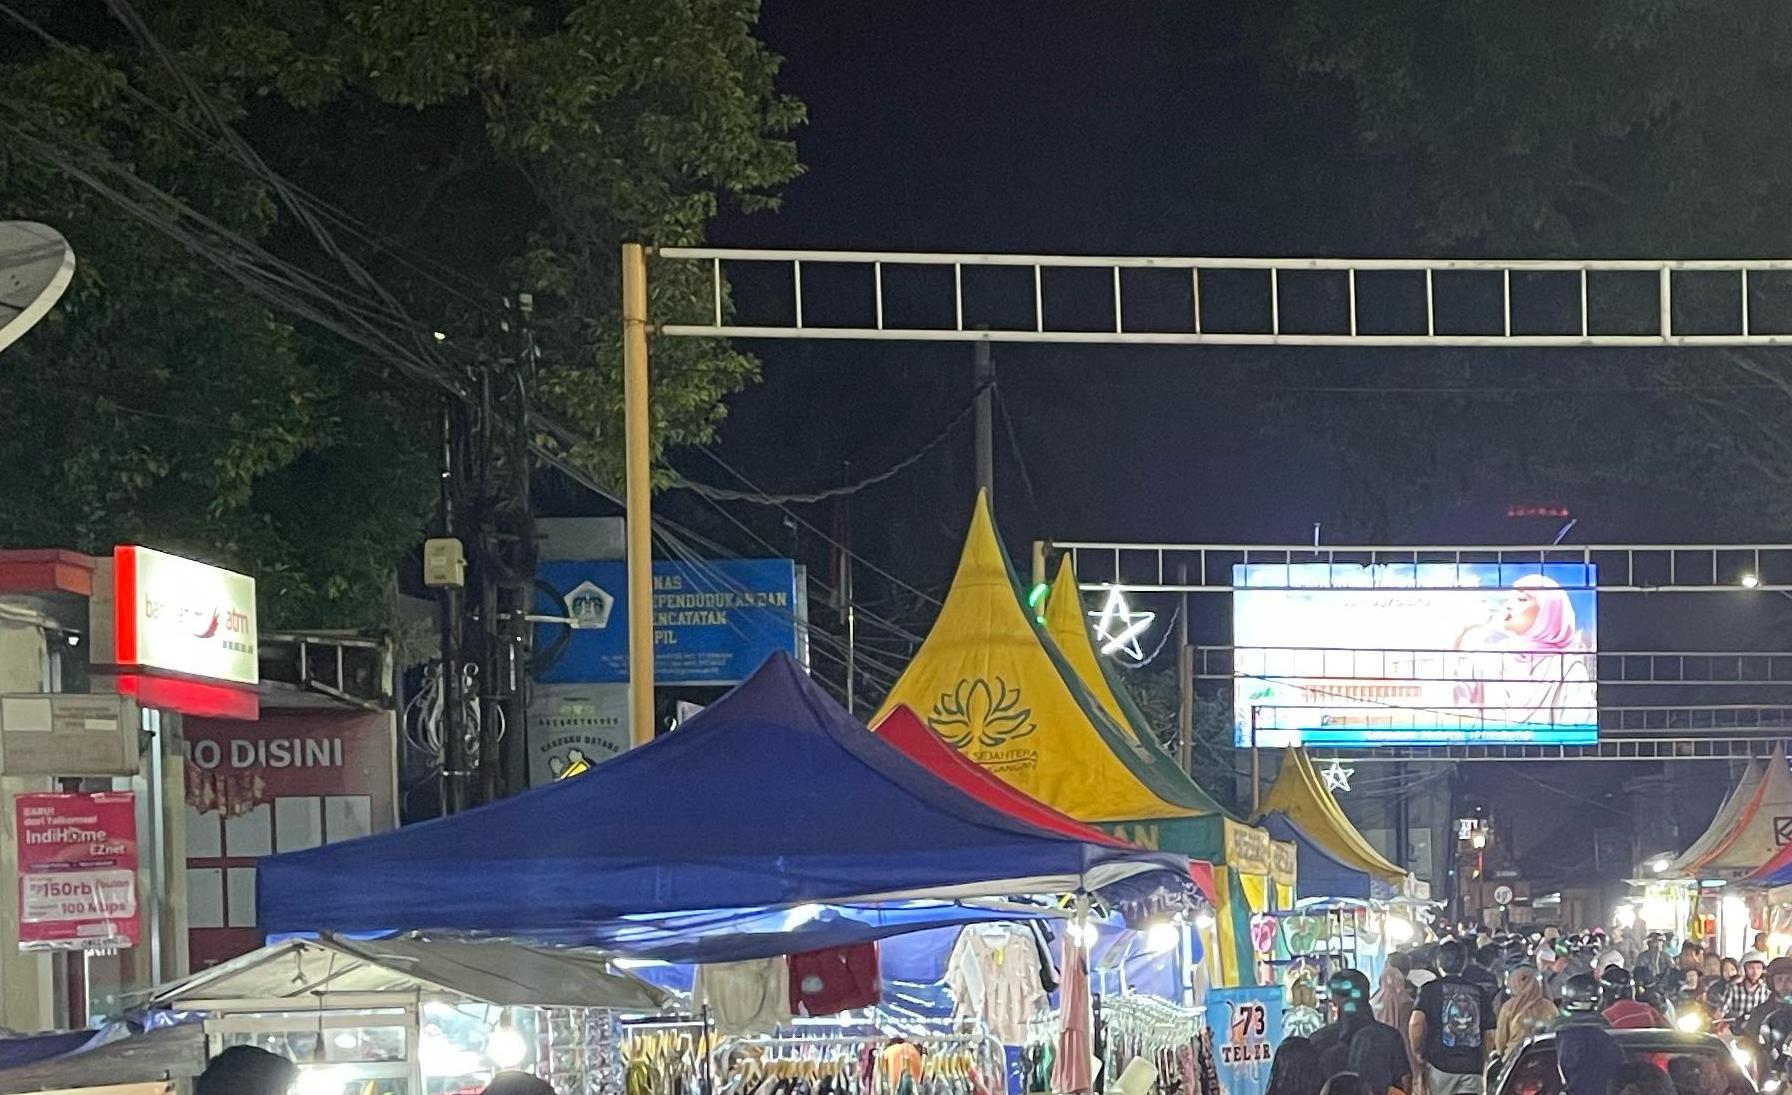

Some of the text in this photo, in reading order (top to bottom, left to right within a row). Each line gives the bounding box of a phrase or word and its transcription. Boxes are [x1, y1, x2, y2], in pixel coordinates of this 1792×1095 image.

[226, 607, 250, 635] atm
[230, 737, 344, 769] DISINI
[1239, 1005, 1266, 1036] 73
